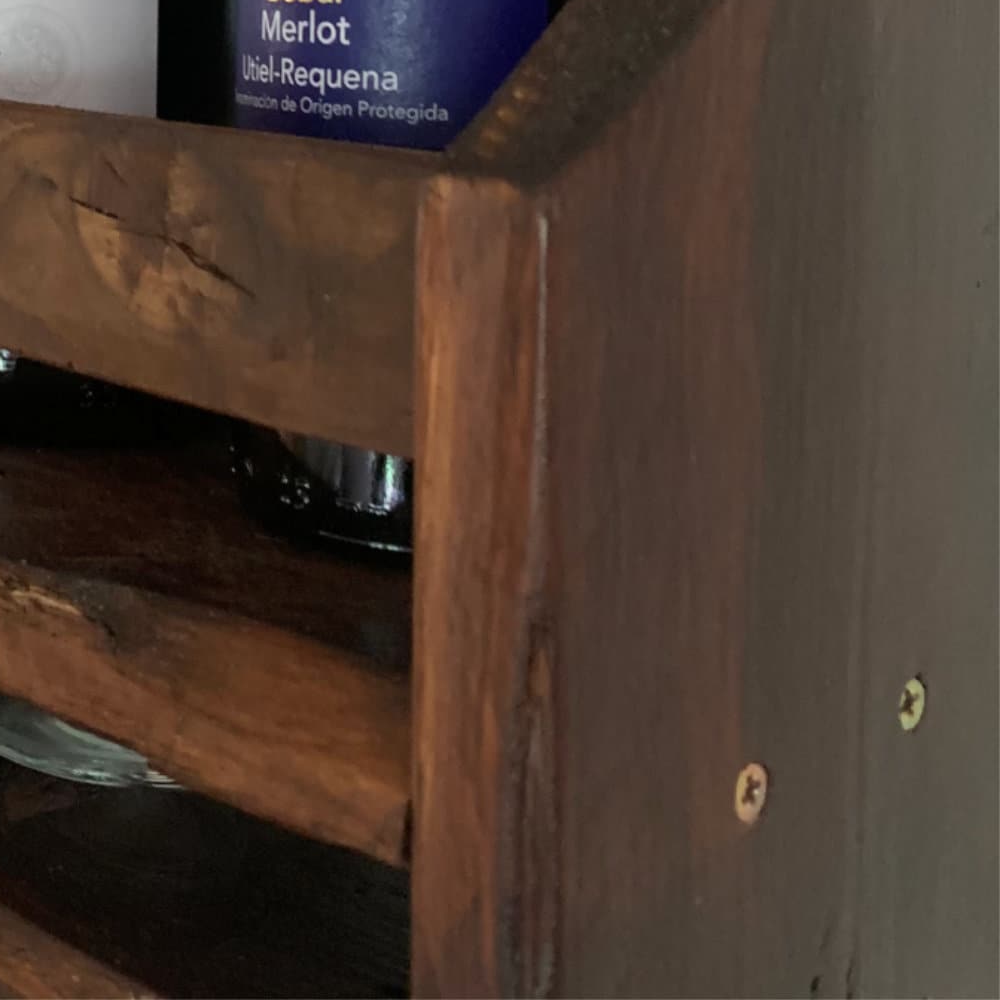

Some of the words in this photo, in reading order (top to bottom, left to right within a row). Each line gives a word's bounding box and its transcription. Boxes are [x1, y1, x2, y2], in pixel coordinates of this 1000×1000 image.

[260, 9, 351, 46] Merlot
[241, 55, 399, 95] Utiel-Requena
[300, 95, 353, 121] Origen
[357, 100, 449, 125] Protegida
